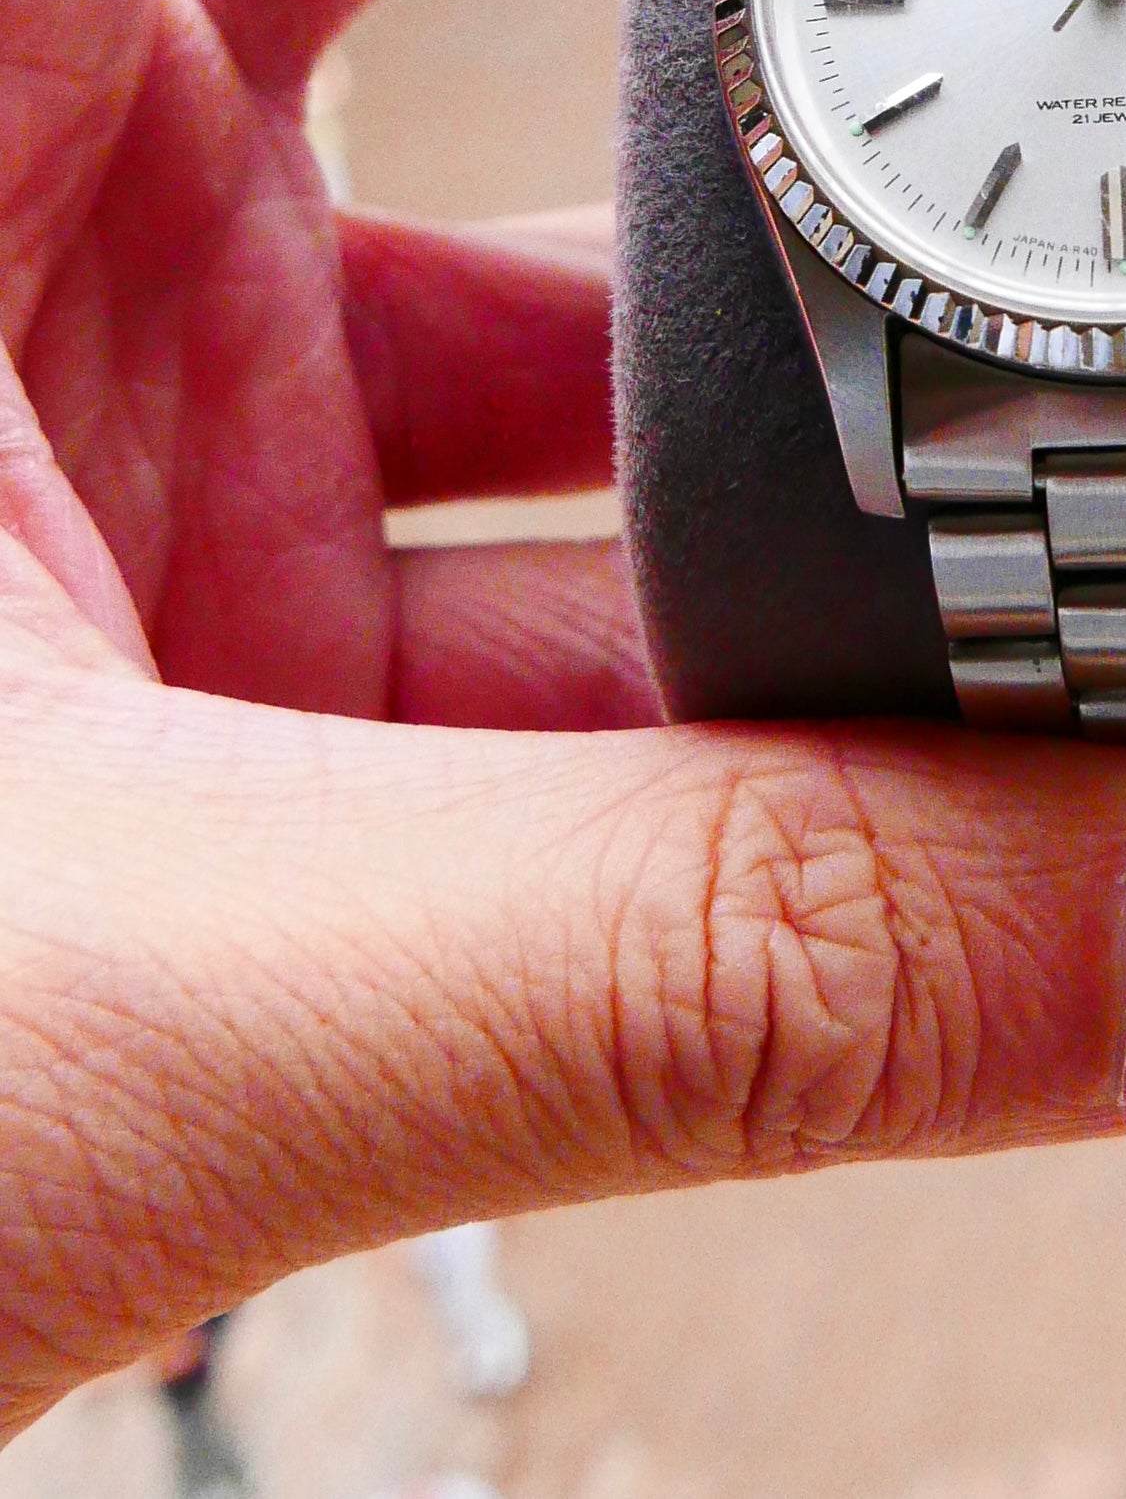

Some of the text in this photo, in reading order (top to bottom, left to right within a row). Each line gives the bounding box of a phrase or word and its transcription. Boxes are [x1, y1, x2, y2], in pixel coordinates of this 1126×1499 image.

[1036, 98, 1098, 111] WATER
[1072, 114, 1090, 125] 21
[1013, 234, 1055, 251] JAPAN
